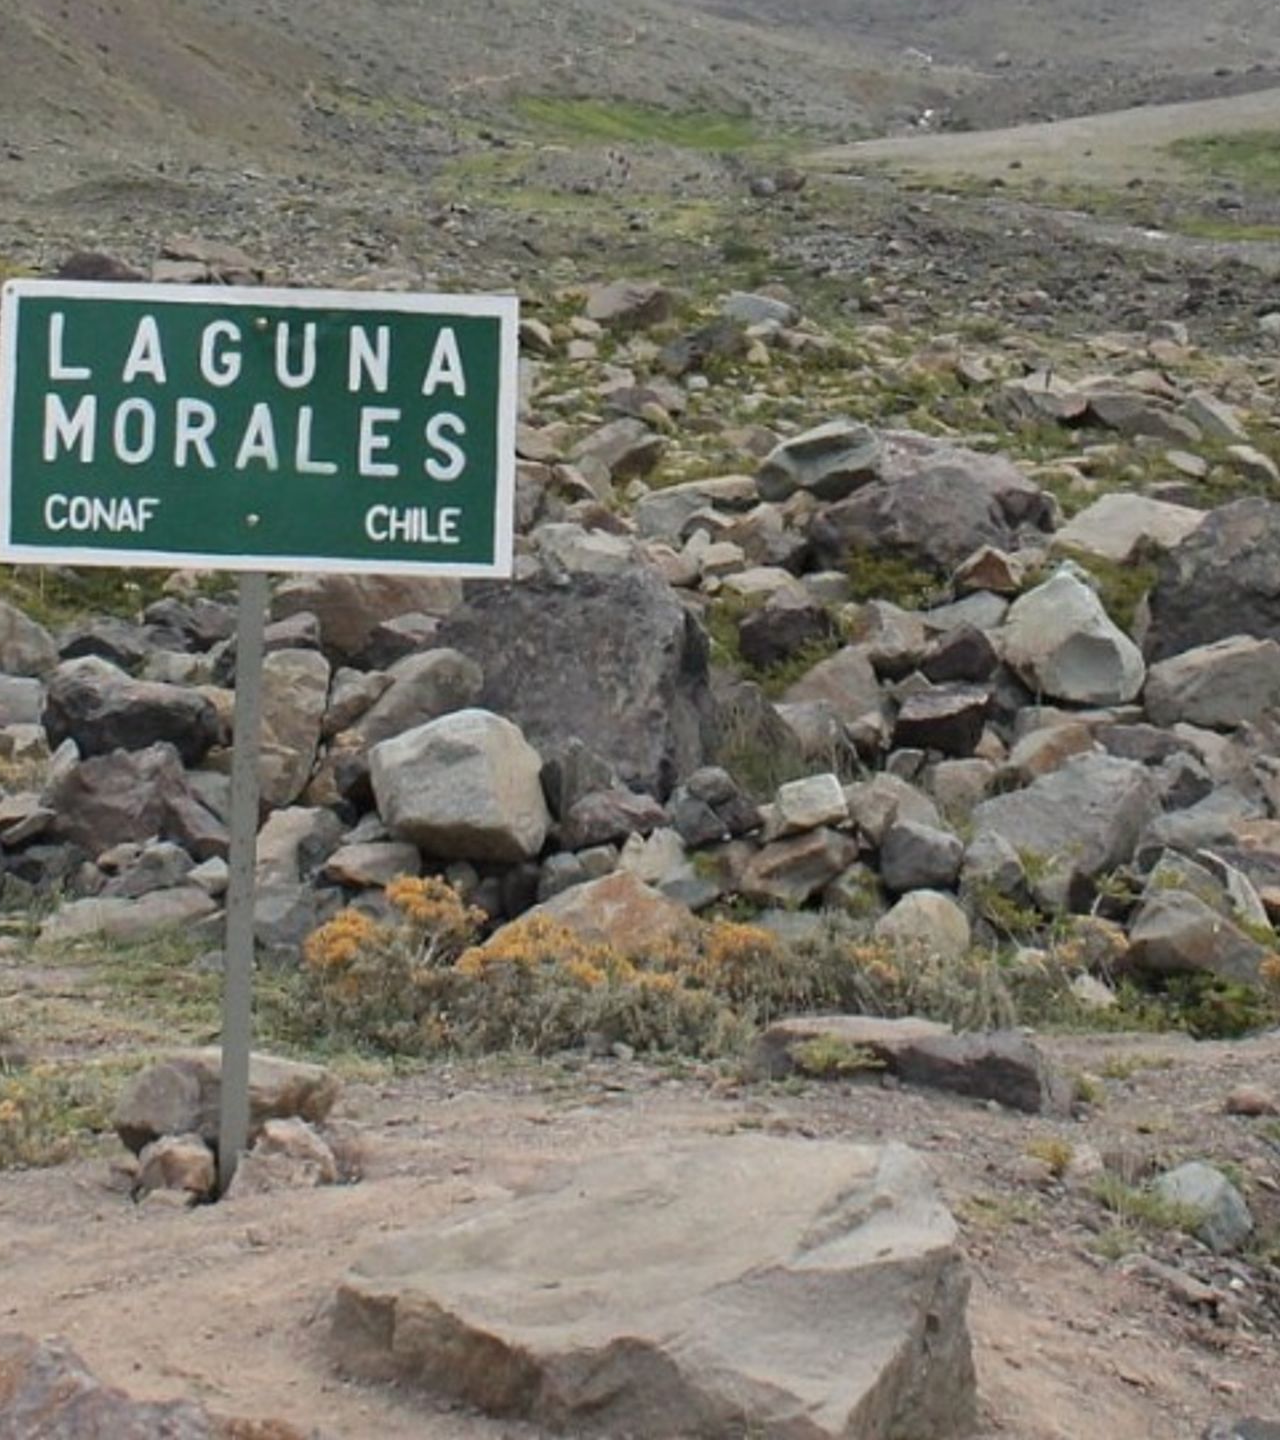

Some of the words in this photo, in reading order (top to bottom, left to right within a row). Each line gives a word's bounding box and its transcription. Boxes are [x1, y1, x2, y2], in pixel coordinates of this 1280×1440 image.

[48, 312, 466, 397] LAGUNA
[42, 393, 467, 481] MORALES
[44, 493, 160, 532] CONAF
[365, 504, 462, 544] CHILE
